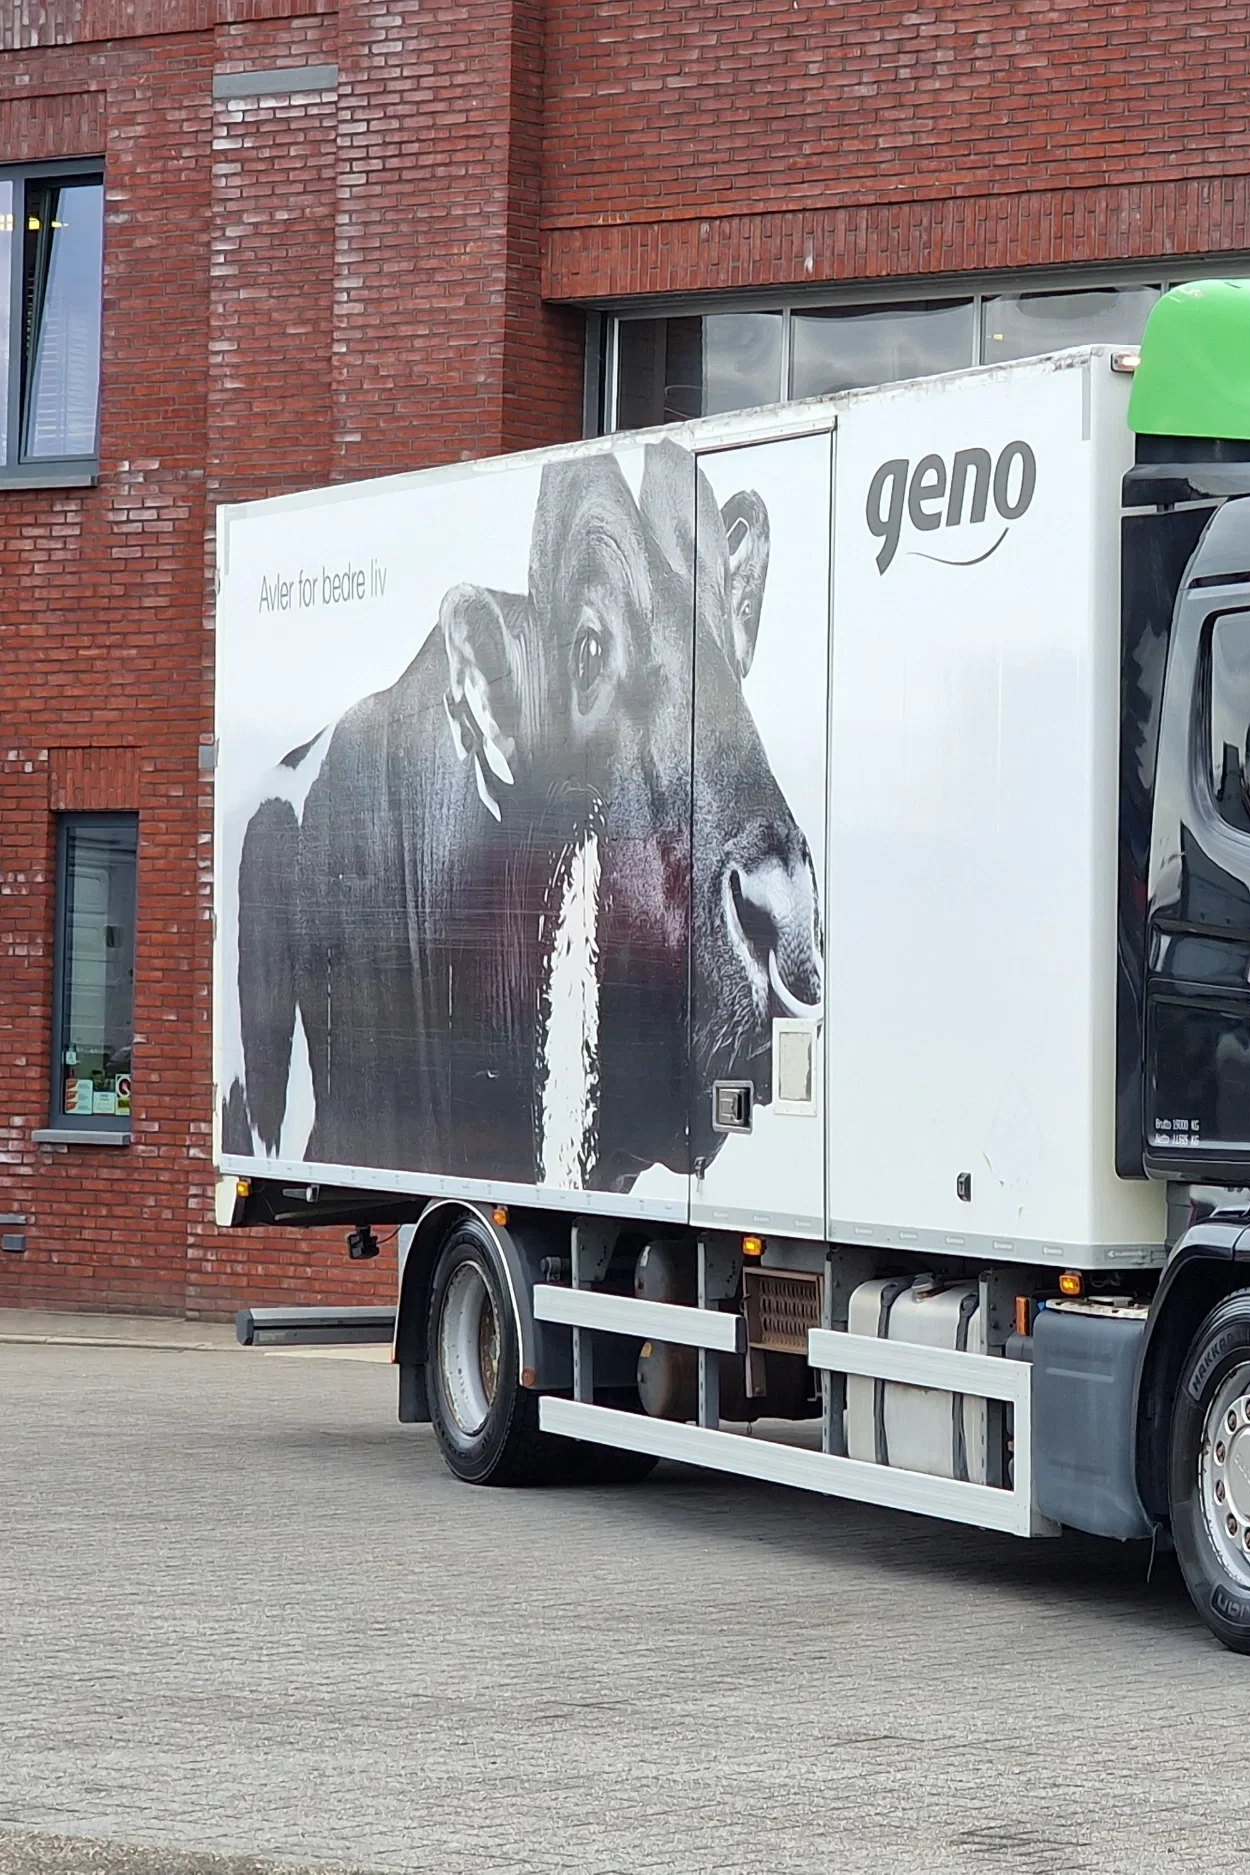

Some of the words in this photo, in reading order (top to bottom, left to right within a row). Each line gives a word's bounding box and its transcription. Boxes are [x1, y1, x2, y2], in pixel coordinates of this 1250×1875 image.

[866, 440, 1037, 577] geno
[258, 573, 294, 613] Avler
[298, 568, 318, 608] for
[322, 561, 366, 604] bedre
[370, 557, 387, 598] liv
[1190, 1119, 1200, 1131] KG
[1190, 1134, 1200, 1147] KG
